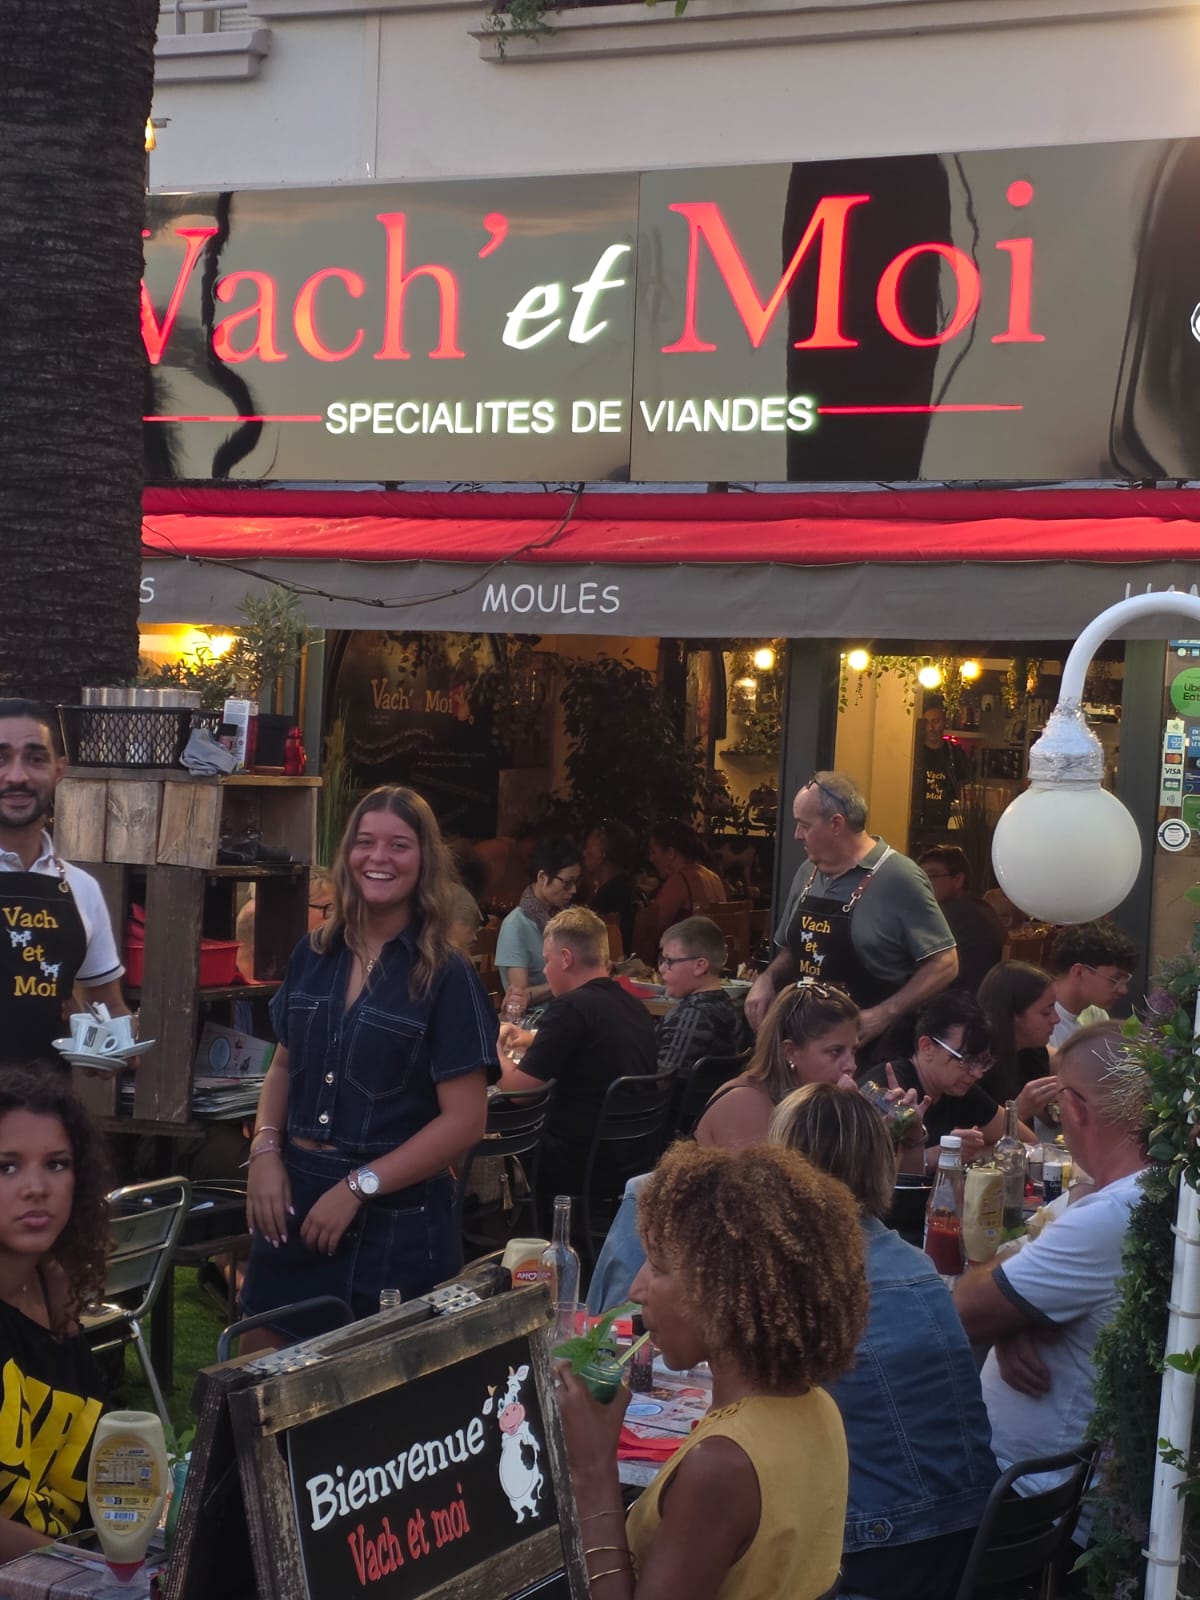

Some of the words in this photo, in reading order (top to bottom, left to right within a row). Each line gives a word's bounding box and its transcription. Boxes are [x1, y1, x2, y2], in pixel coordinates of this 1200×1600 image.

[503, 244, 632, 350] et
[661, 180, 1046, 354] Moi
[325, 401, 555, 435] SPECIALITES
[570, 400, 622, 433] DE
[640, 397, 815, 432] VIANDES
[481, 583, 620, 614] MOULES
[1164, 767, 1181, 775] VISA
[2, 906, 59, 928] Vach
[802, 916, 831, 933] Vach
[23, 945, 45, 962] et
[805, 942, 818, 953] et
[800, 960, 820, 975] Moi
[14, 976, 57, 996] Moi
[305, 1417, 485, 1531] Bienvenue
[347, 1524, 404, 1586] Vach
[407, 1508, 430, 1559] et
[430, 1481, 470, 1548] moi
